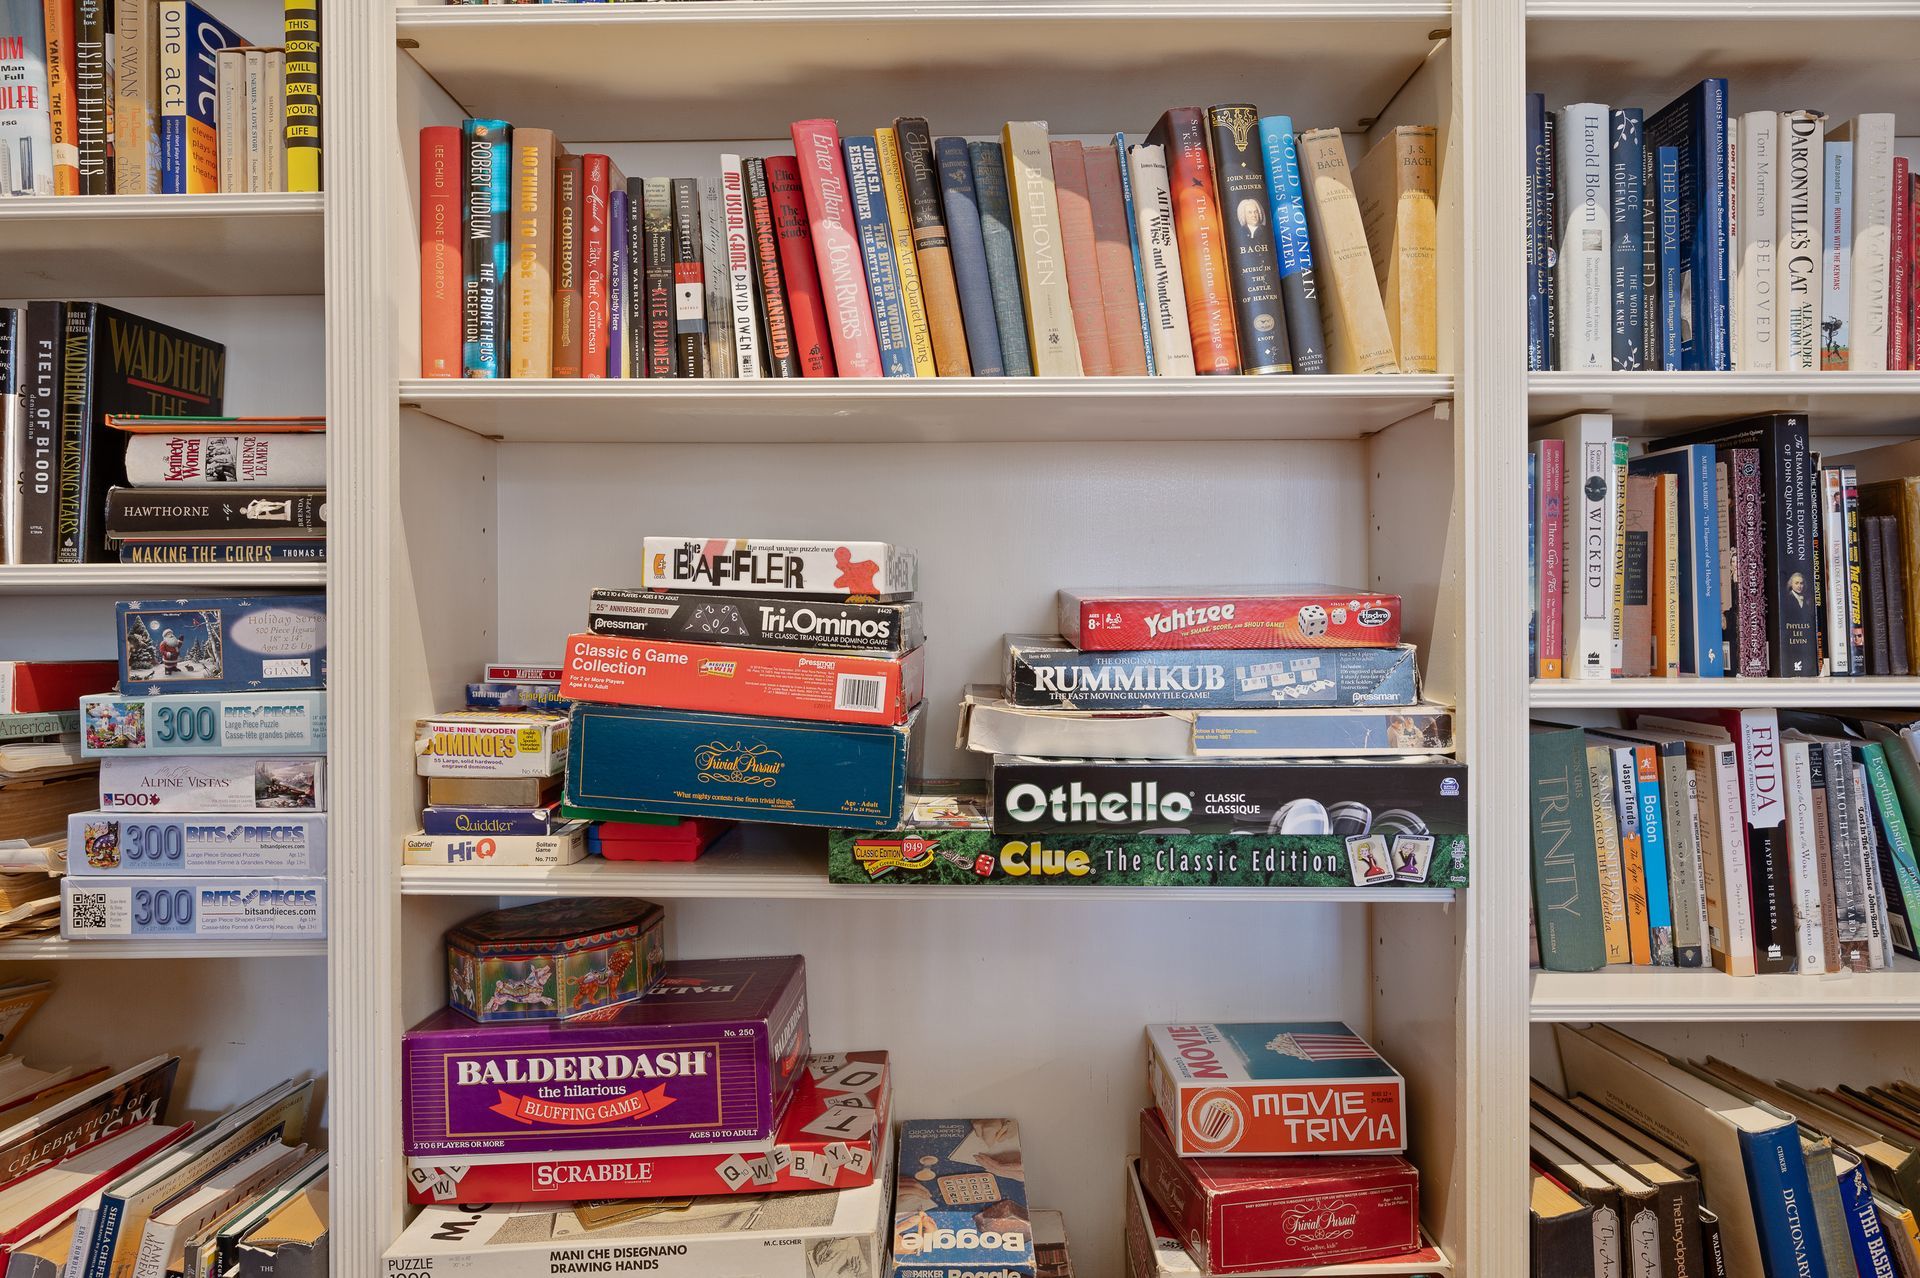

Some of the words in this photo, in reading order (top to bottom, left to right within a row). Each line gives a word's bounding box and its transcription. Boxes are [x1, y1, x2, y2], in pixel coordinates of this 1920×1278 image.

[165, 10, 180, 54] one
[289, 21, 309, 29] THIS
[286, 42, 314, 51] BOOK
[77, 43, 102, 90] OSCAR
[289, 63, 311, 72] WILL
[165, 67, 184, 108] act
[288, 84, 312, 93] SAVE
[287, 106, 314, 115] YOUR
[291, 127, 308, 135] LIFE
[1585, 117, 1599, 167] Harold
[1757, 130, 1769, 157] Toni
[434, 160, 444, 188] CHILD
[471, 142, 491, 187] ROBERT
[906, 131, 926, 182] Haydn
[521, 146, 538, 212] NOTHING
[562, 171, 572, 200] THE
[812, 132, 832, 172] Enter
[822, 176, 843, 230] Talking
[849, 146, 872, 221] EISENHOWER
[1615, 163, 1625, 223] HOFFMAN
[1628, 174, 1638, 211] ALICE
[1757, 162, 1769, 217] Morrison
[1791, 119, 1815, 250] DARCONVILLE'S
[726, 192, 744, 232] USUAL
[1268, 134, 1286, 201] CHARLES
[1278, 205, 1295, 269] FRAZIER
[1586, 173, 1600, 222] Bloom
[435, 204, 445, 236] GONE
[471, 192, 491, 240] LUDLUM
[520, 218, 537, 238] TO
[1026, 168, 1056, 287] BEETHOVEN
[1282, 133, 1300, 188] COLD
[1292, 195, 1316, 300] MOUNTAIN
[521, 245, 537, 278] LOSE
[562, 208, 572, 289] CHOIRBOYS
[729, 234, 748, 271] GAME
[1240, 244, 1268, 254] BACH
[434, 238, 445, 300] TOMORROW
[480, 262, 493, 280] THE
[1616, 266, 1624, 288] THAT
[1788, 256, 1813, 295] CAT
[734, 274, 748, 311] DAVID
[1156, 269, 1175, 330] Wonderful
[1757, 239, 1770, 343] BELOVED
[468, 282, 478, 342] DECEPTION
[480, 284, 494, 362] PROMETHEUS
[888, 302, 904, 349] WOODS
[1616, 311, 1625, 334] KNEW
[652, 320, 668, 374] RUNNER
[738, 317, 752, 351] OWEN
[1790, 307, 1801, 357] THEROUX
[1802, 301, 1812, 369] ALEXANDER
[37, 340, 52, 398] FIELD
[108, 317, 225, 400] WALDHEIM
[37, 408, 50, 432] OF
[35, 440, 49, 494] BLOOD
[165, 437, 187, 482] Kennedy
[182, 438, 201, 481] Women
[243, 436, 256, 481] LAURENCE
[255, 440, 269, 477] LEAMER
[124, 506, 209, 517] HAWTHORNE
[132, 546, 187, 562] MAKING
[192, 546, 217, 562] THE
[225, 545, 272, 562] CORPS
[283, 549, 315, 557] THOMAS
[1590, 507, 1601, 588] WICKED
[1797, 509, 1805, 562] EDUCATION
[673, 548, 804, 588] BAFFLER
[1850, 565, 1860, 581] THE
[609, 605, 646, 614] ANNIVERSARY
[648, 607, 669, 615] EDITION
[1144, 603, 1235, 638] Yahtzee
[1851, 582, 1861, 625] GRIFTERS
[574, 643, 628, 660] Classic
[632, 645, 641, 660] 6
[645, 647, 688, 665] Game
[800, 635, 839, 643] TRIANGULAR
[840, 636, 868, 645] DOMINO
[572, 658, 646, 676] Collection
[1033, 665, 1225, 691] RUMMIKUB
[1090, 692, 1127, 700] MOVING
[157, 706, 214, 742] 300
[225, 720, 242, 729] Large
[260, 720, 279, 729] Puzzle
[695, 751, 738, 774] Trivial
[738, 752, 781, 775] Pursuit
[1622, 763, 1632, 796] Jasper
[1752, 726, 1777, 812] FRIDA
[114, 793, 148, 806] 500
[140, 776, 184, 788] ALPINE
[188, 776, 229, 787] VISTAS
[1205, 793, 1245, 803] CLASSIC
[1872, 756, 1895, 818] Everything
[1006, 781, 1193, 824] Othello
[1205, 805, 1260, 815] CLASSIQUE
[1626, 797, 1636, 826] Fforde
[1644, 795, 1657, 844] Boston
[1834, 776, 1849, 840] TIMOTHY
[186, 826, 226, 843] BITS
[244, 826, 305, 843] PIECES
[455, 815, 513, 831] Quiddler
[1538, 764, 1581, 918] TRINITY
[126, 824, 183, 860] 300
[407, 840, 432, 848] Gabriel
[903, 842, 923, 852] 1949
[1000, 840, 1091, 877] Clue
[1105, 848, 1144, 874] The
[1155, 846, 1238, 874] Classic
[1252, 848, 1337, 872] Edition
[1765, 839, 1773, 880] HAYDEN
[1844, 855, 1852, 885] LOUIS
[134, 889, 192, 925] 300
[202, 890, 241, 907] BITS
[259, 890, 317, 907] PIECES
[1768, 885, 1777, 931] HERRERA
[1847, 891, 1856, 934] BAYARD
[456, 1051, 707, 1086] BALDERDASH
[525, 1098, 595, 1120] BLUFFING
[598, 1097, 642, 1119] GAME
[538, 1085, 562, 1098] the
[563, 1084, 627, 1098] hilarious
[1252, 1088, 1367, 1118] MOVIE
[8, 1104, 121, 1174] CELEBRATION
[1284, 1113, 1396, 1144] TRIVIA
[536, 1162, 652, 1189] SCRABBLE
[1777, 1146, 1787, 1173] CIRKER
[1282, 1215, 1320, 1234] Trivial
[1320, 1213, 1357, 1228] Pursuit
[1673, 1196, 1683, 1217] The
[1859, 1205, 1880, 1238] THE
[902, 1228, 1025, 1253] Boggle
[1783, 1187, 1812, 1278] DICTIONARY
[388, 1258, 433, 1272] PUZZLE
[550, 1249, 585, 1262] MANI
[587, 1247, 611, 1260] CHE
[613, 1245, 687, 1259] DISEGNANO
[550, 1260, 612, 1274] DRAWING
[615, 1259, 659, 1272] HANDS
[1712, 1232, 1724, 1276] WALDMAN
